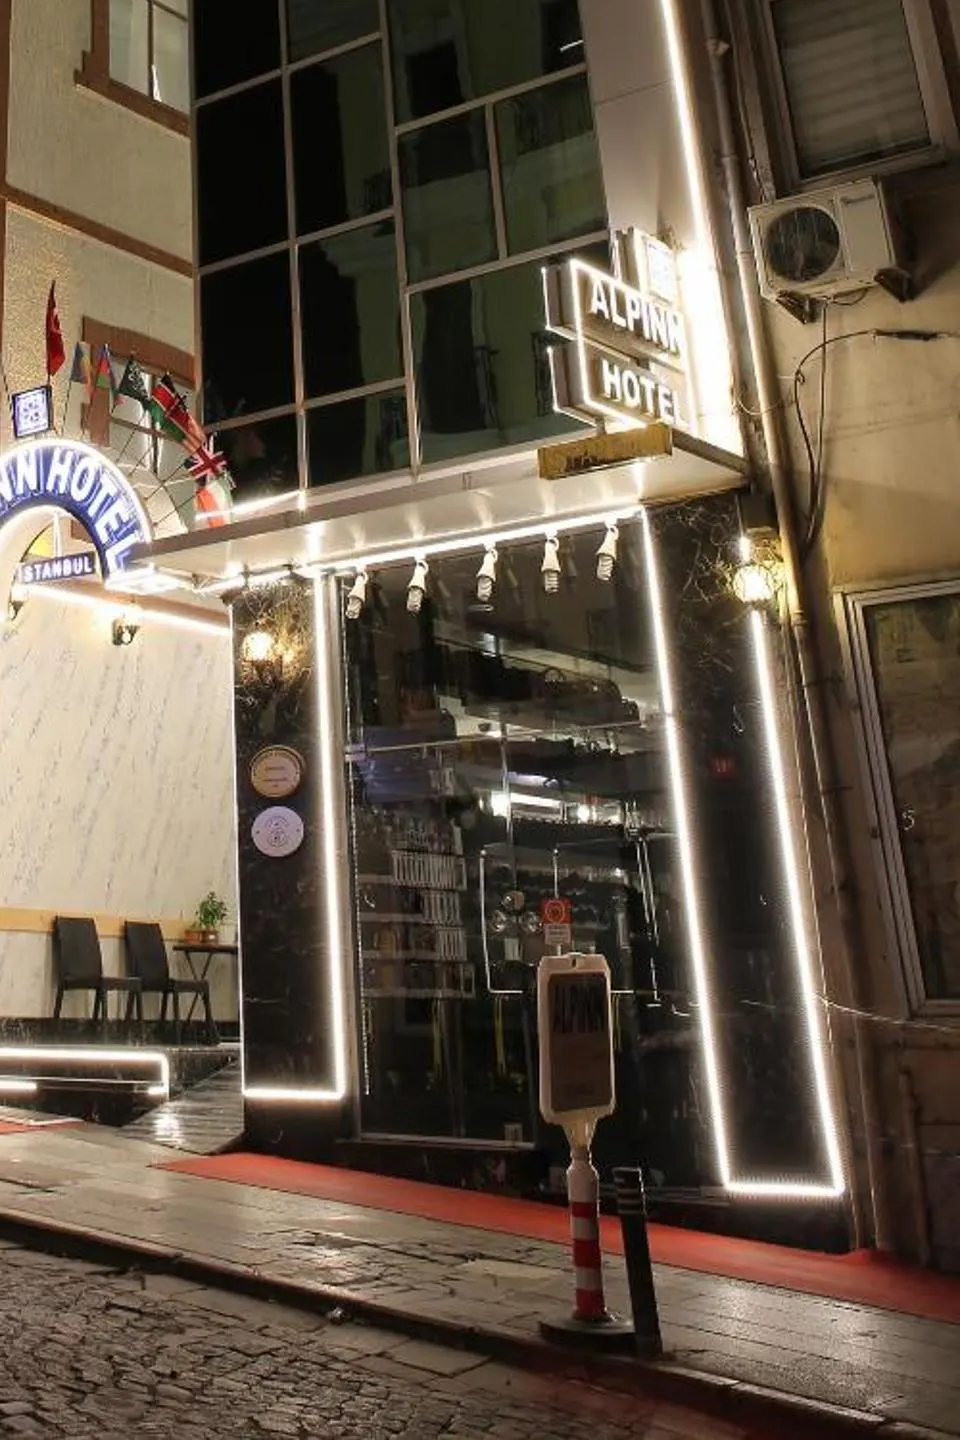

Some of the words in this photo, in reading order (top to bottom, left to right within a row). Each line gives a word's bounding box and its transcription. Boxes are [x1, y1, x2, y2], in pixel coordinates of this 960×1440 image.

[589, 273, 685, 357] ALPINN
[601, 359, 690, 427] HOTEL
[44, 446, 139, 580] HOTEL
[18, 555, 95, 583] ISTANBUL
